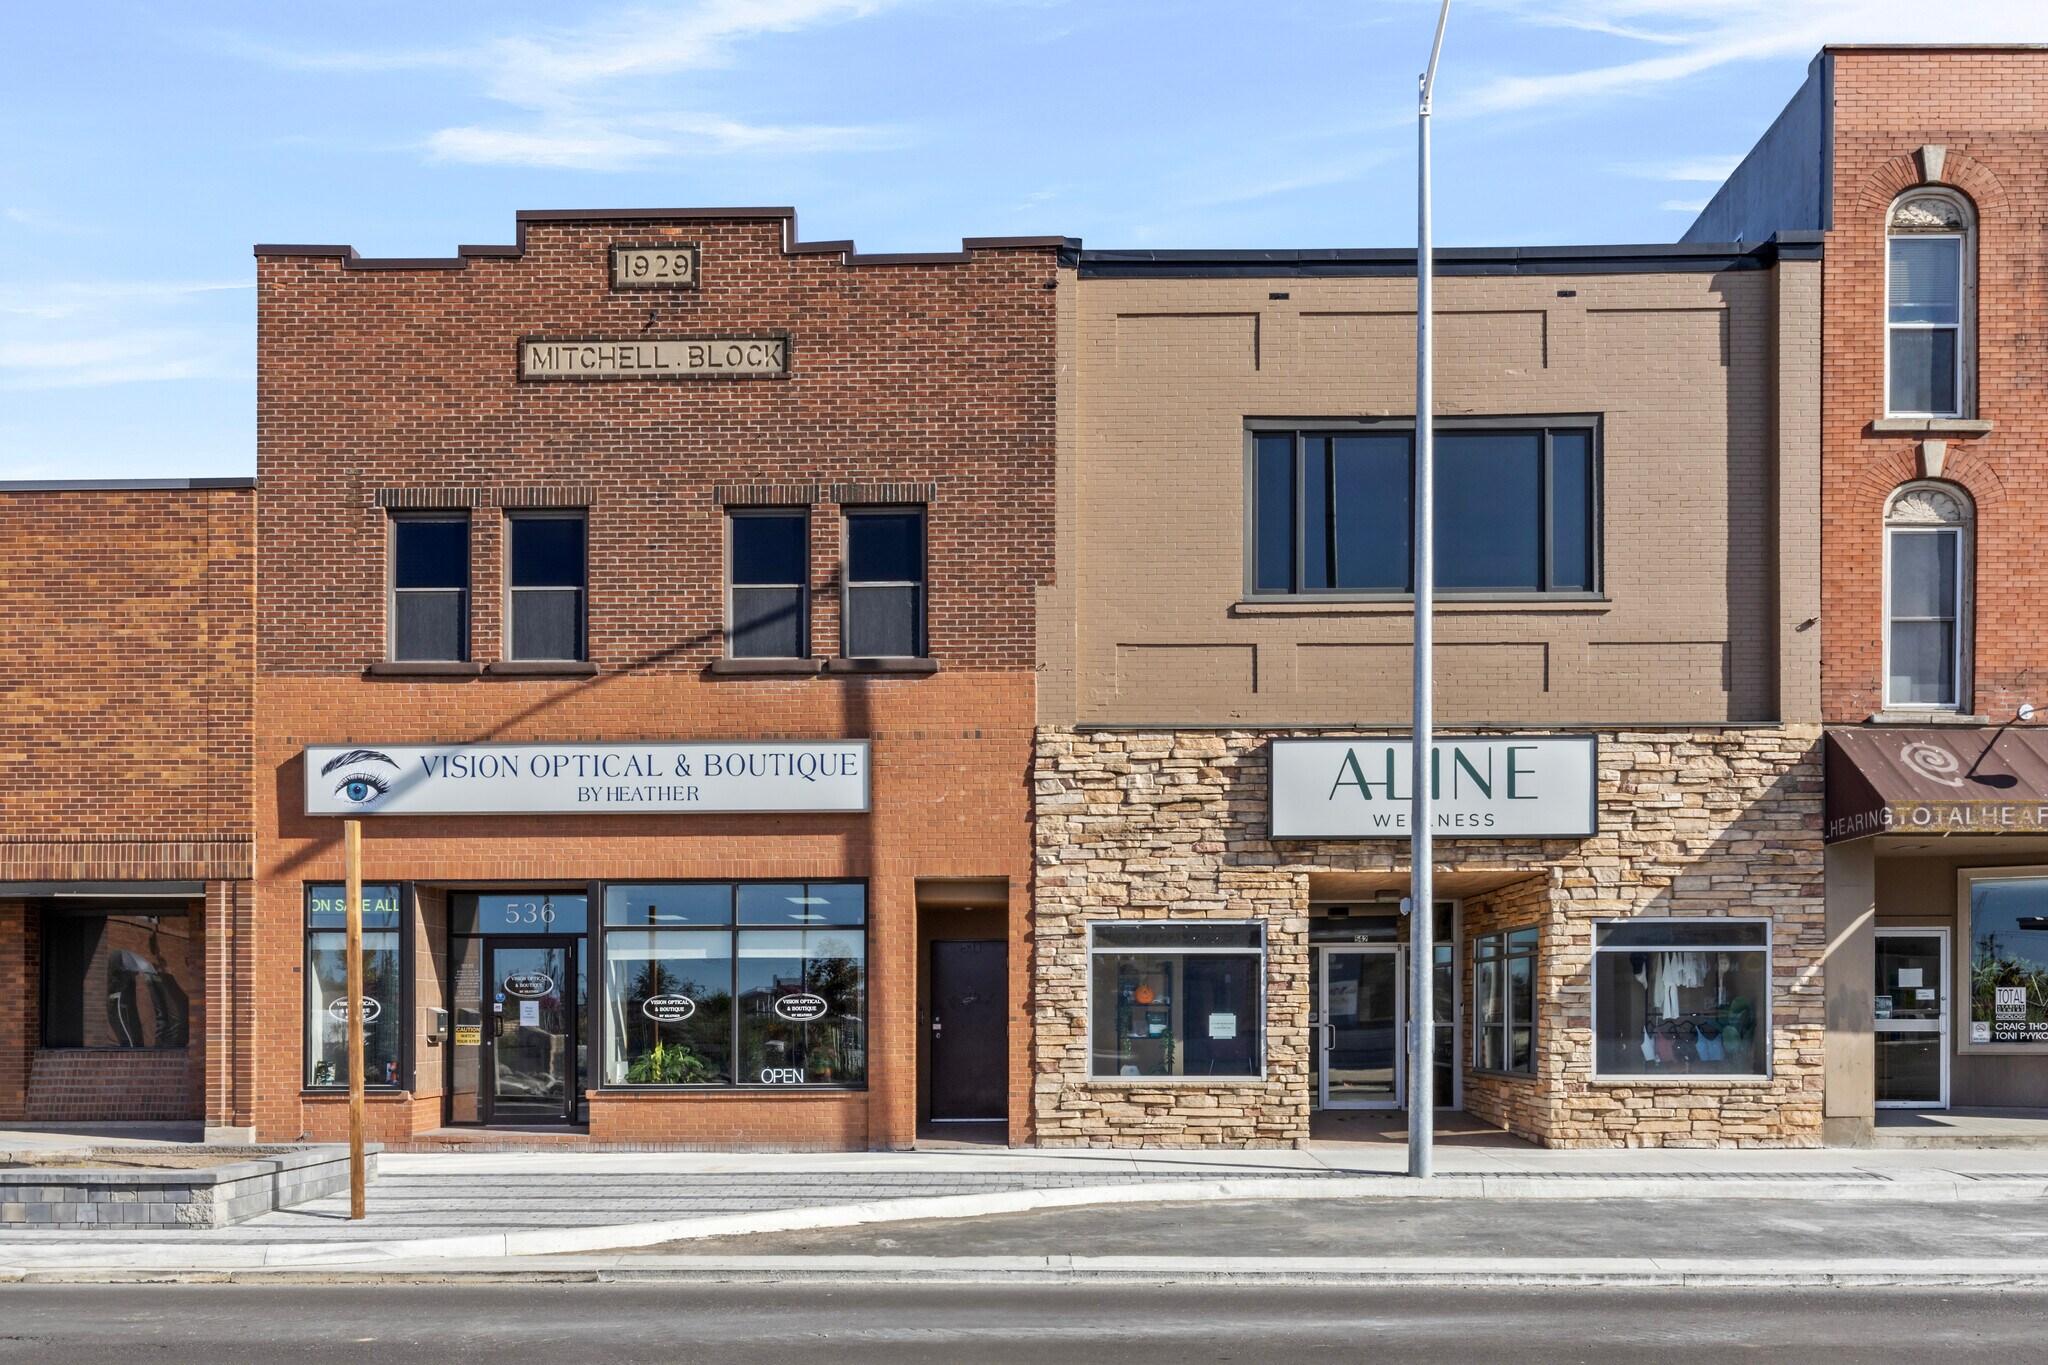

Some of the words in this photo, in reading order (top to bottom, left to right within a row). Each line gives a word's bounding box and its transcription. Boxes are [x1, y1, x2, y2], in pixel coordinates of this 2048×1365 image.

[624, 255, 689, 277] 1929
[532, 346, 670, 370] MITCHELL
[688, 345, 781, 368] BLOCK
[420, 754, 519, 778] VISION
[530, 753, 663, 778] OPTICAL
[675, 753, 692, 777] &
[704, 753, 858, 782] BOUTIQUE
[578, 786, 602, 802] BY
[607, 786, 699, 801] HEATHER
[1373, 813, 1495, 827] WENESS
[312, 899, 331, 912] ON
[334, 899, 371, 912] SE
[374, 899, 399, 912] ALL
[505, 903, 556, 923] 536
[1998, 989, 2024, 1004] TOTAL
[1995, 1022, 2026, 1031] CRAIG
[1995, 1032, 2018, 1040] TONI
[2020, 1032, 2048, 1040] PYYKO
[761, 1068, 804, 1083] OPEN
